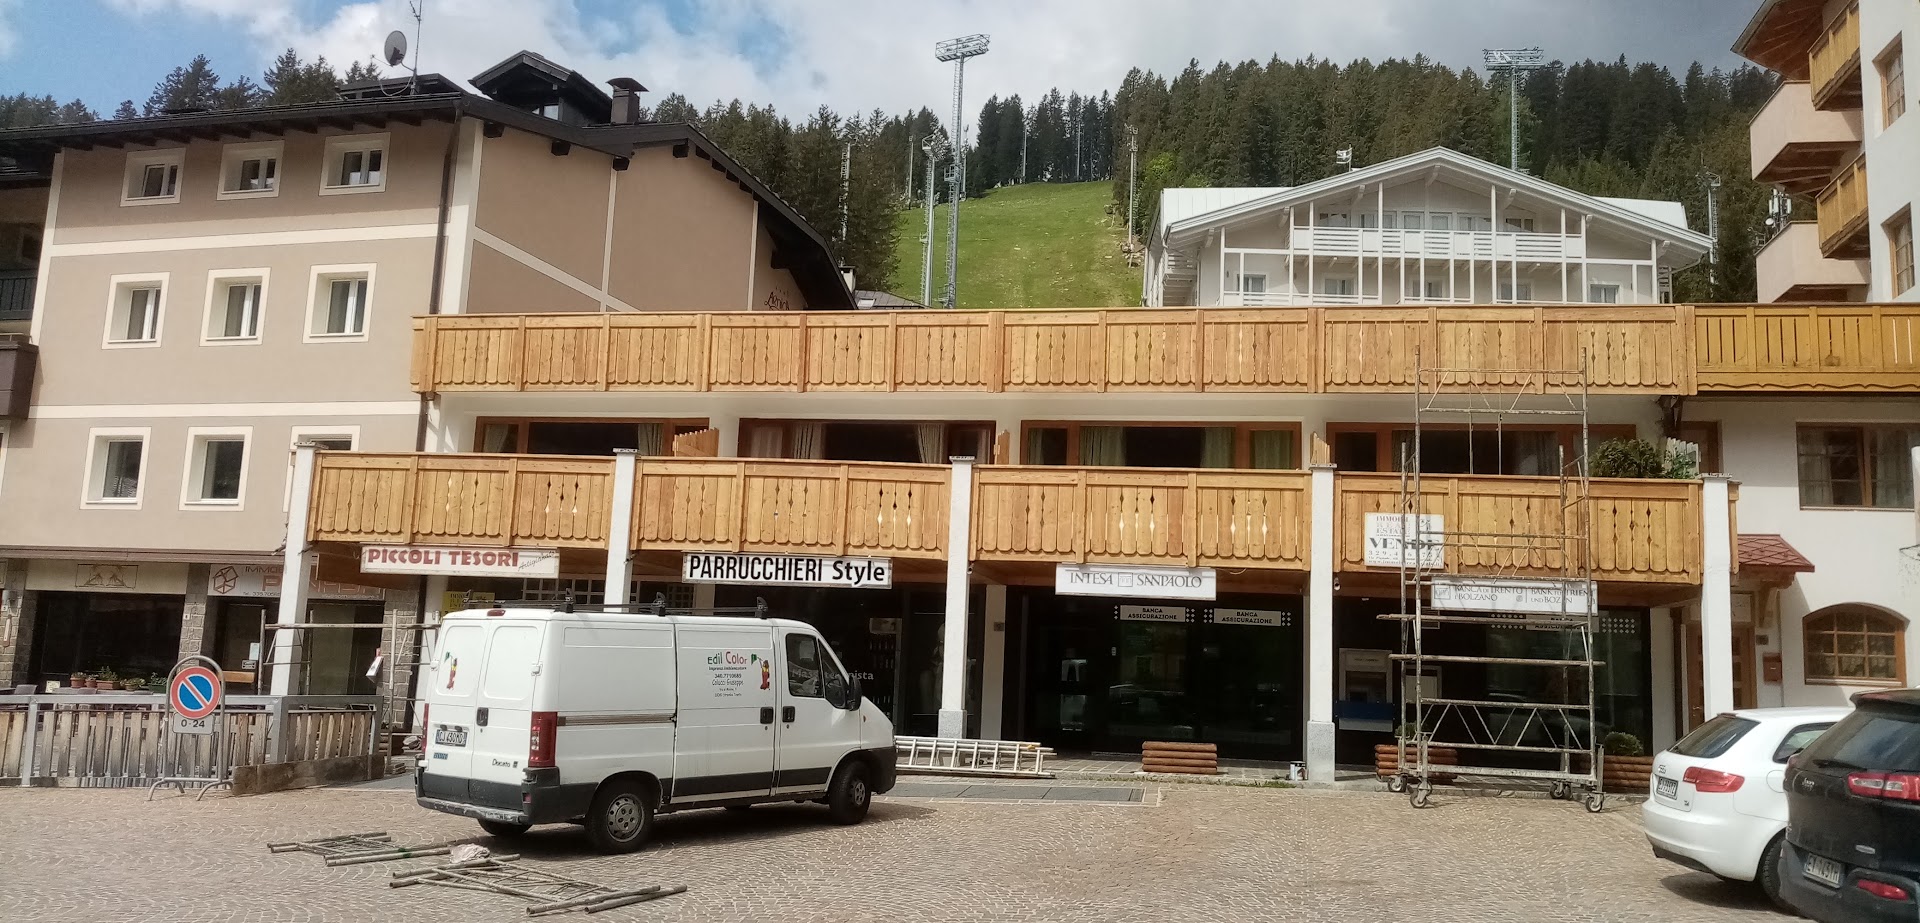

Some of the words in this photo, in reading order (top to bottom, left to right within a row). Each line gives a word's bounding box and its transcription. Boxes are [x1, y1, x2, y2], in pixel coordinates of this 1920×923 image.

[368, 548, 441, 565] PICCOLI
[448, 550, 519, 567] TESORI
[689, 555, 823, 582] PARRUCCHIERI
[832, 559, 885, 585] Style
[1070, 572, 1113, 585] INTESA
[1136, 573, 1202, 588] SANPAOLO
[1490, 586, 1523, 595] TRENTO
[1458, 592, 1498, 601] BOLZANO
[1544, 596, 1573, 604] BOZN
[1221, 616, 1272, 624] ASSICURAZIONE
[707, 652, 723, 665] Edil
[725, 651, 747, 665] Color
[491, 758, 511, 767] Ducato
